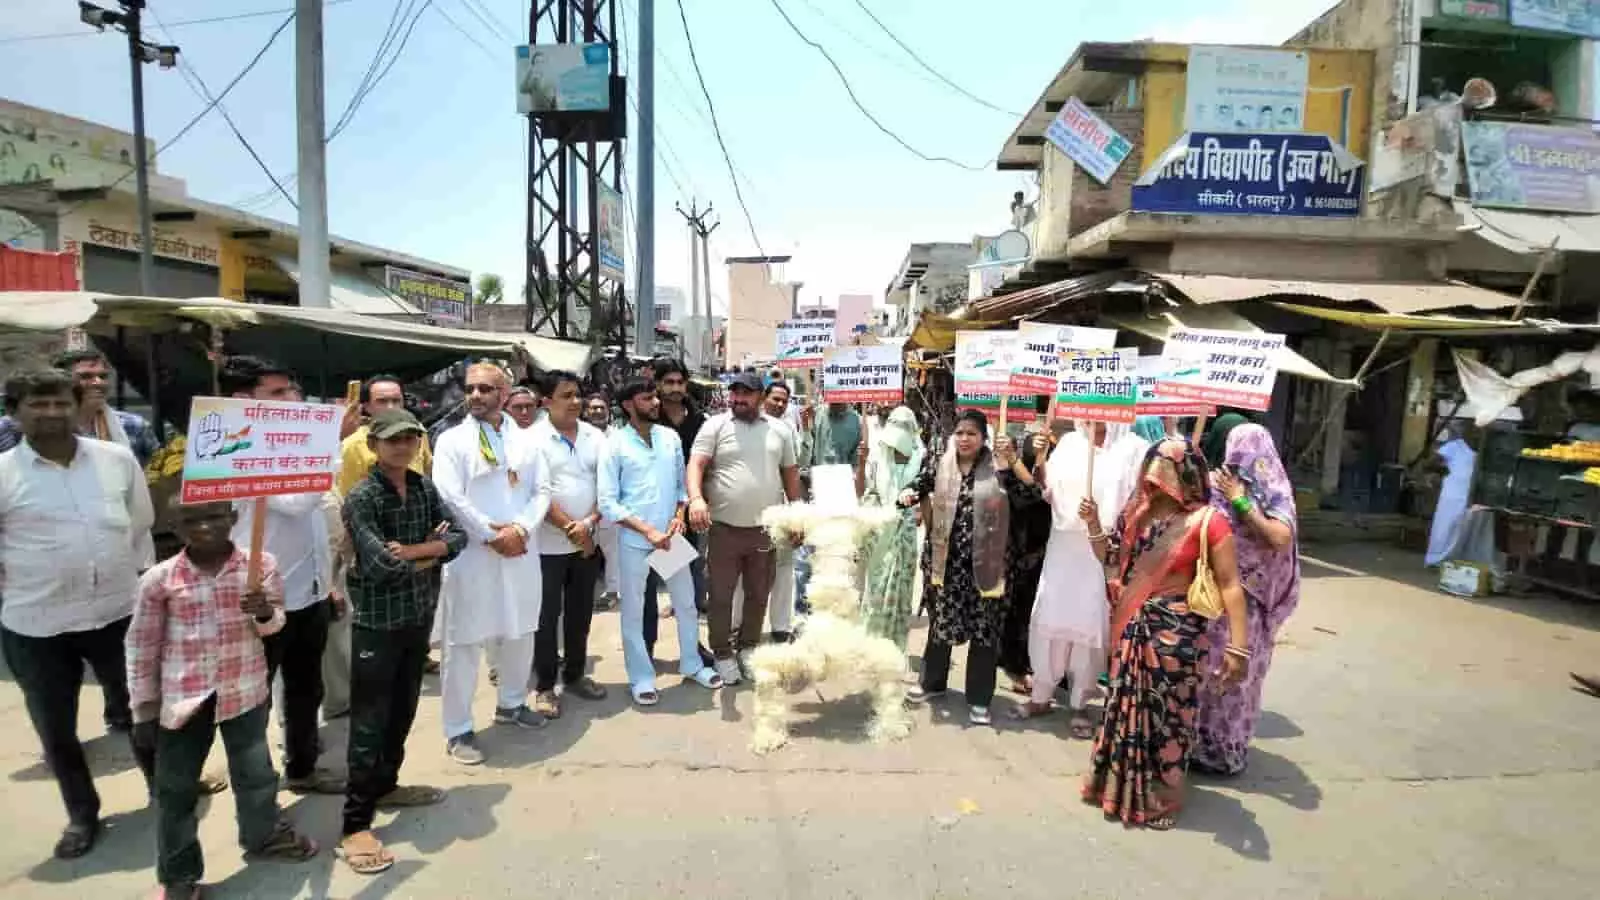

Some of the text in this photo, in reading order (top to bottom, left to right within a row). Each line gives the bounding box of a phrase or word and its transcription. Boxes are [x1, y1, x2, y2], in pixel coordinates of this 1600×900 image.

[1204, 138, 1275, 181] विद्यापीठ
[1197, 188, 1234, 208] सीकरी
[1094, 376, 1132, 399] विरोधी
[232, 457, 274, 472] करना
